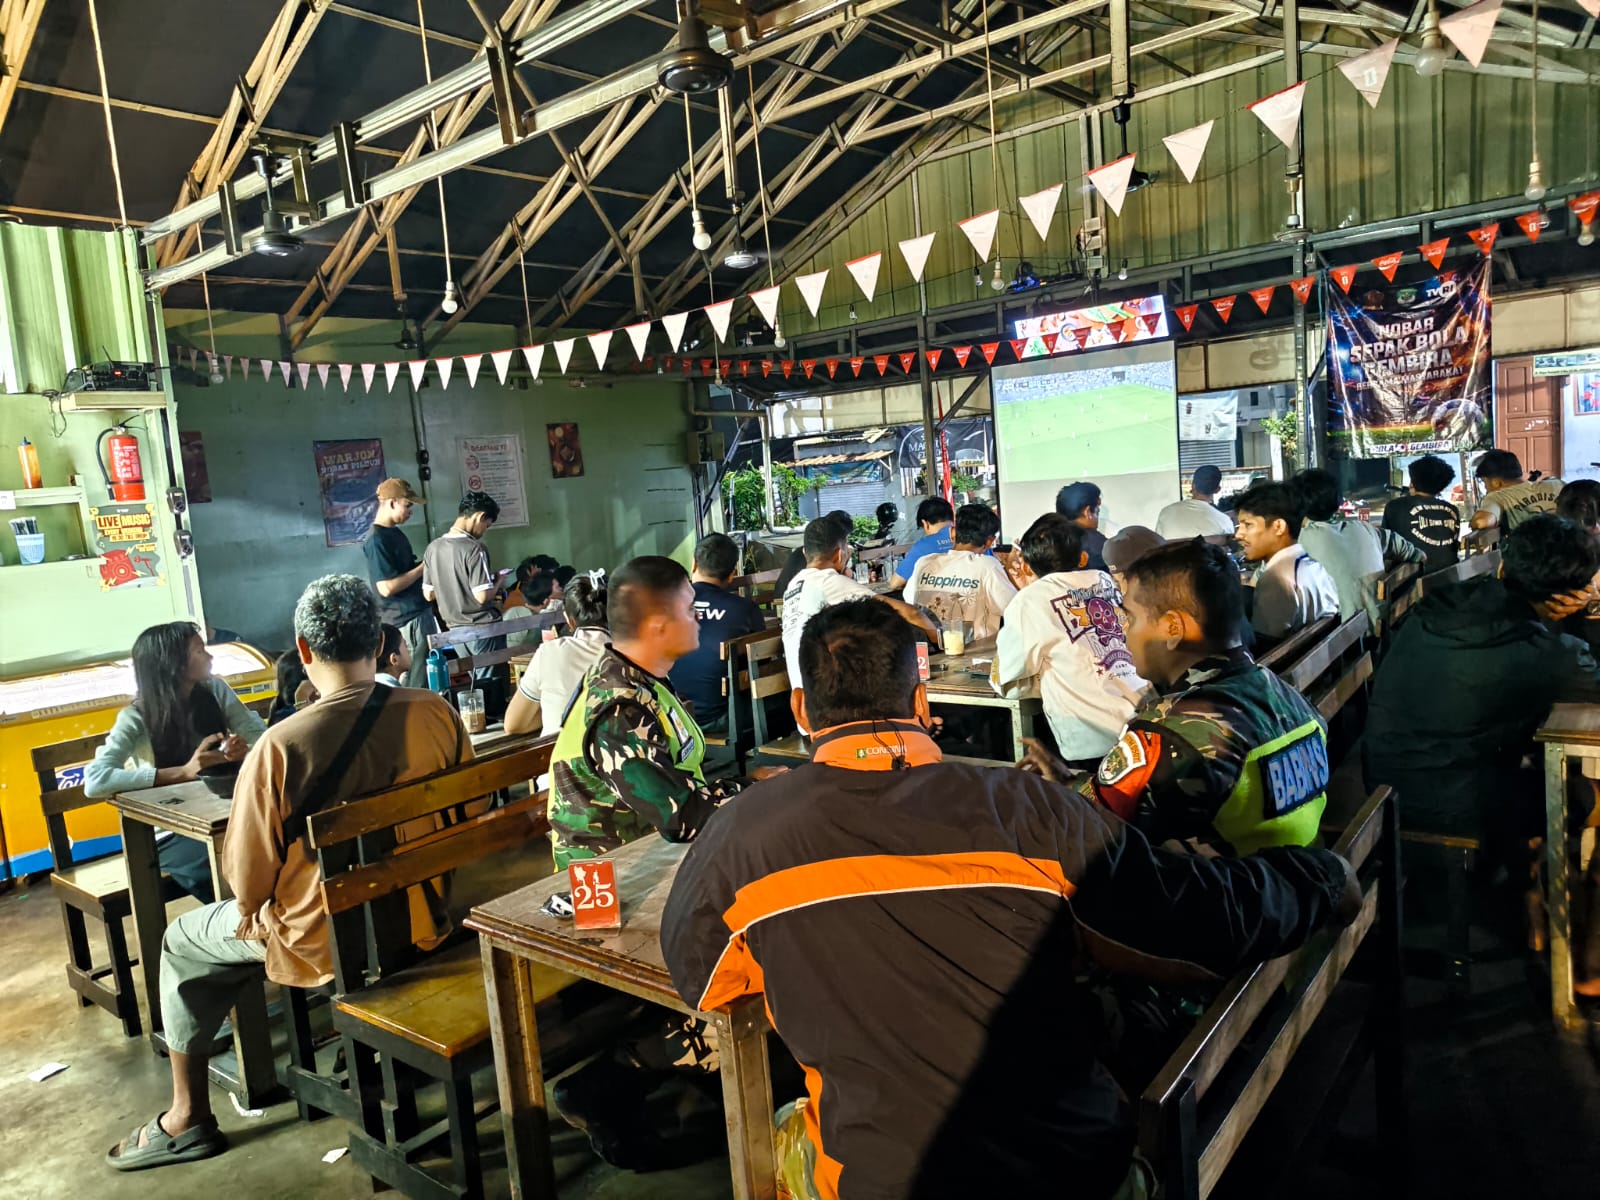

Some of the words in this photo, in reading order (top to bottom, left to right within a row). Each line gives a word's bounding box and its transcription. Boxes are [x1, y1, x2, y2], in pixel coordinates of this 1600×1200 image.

[1426, 282, 1455, 297] TVRI
[1379, 317, 1434, 338] NOBAR
[1350, 338, 1410, 363] SEPAK
[1415, 326, 1468, 350] BOLA
[1514, 493, 1557, 511] PARADIS
[98, 516, 120, 528] LIVE
[121, 514, 151, 527] MUSIC
[920, 573, 980, 589] Happines
[695, 608, 726, 620] EW
[917, 656, 927, 669] 2
[1268, 737, 1329, 811] BABINS
[574, 882, 614, 910] 25
